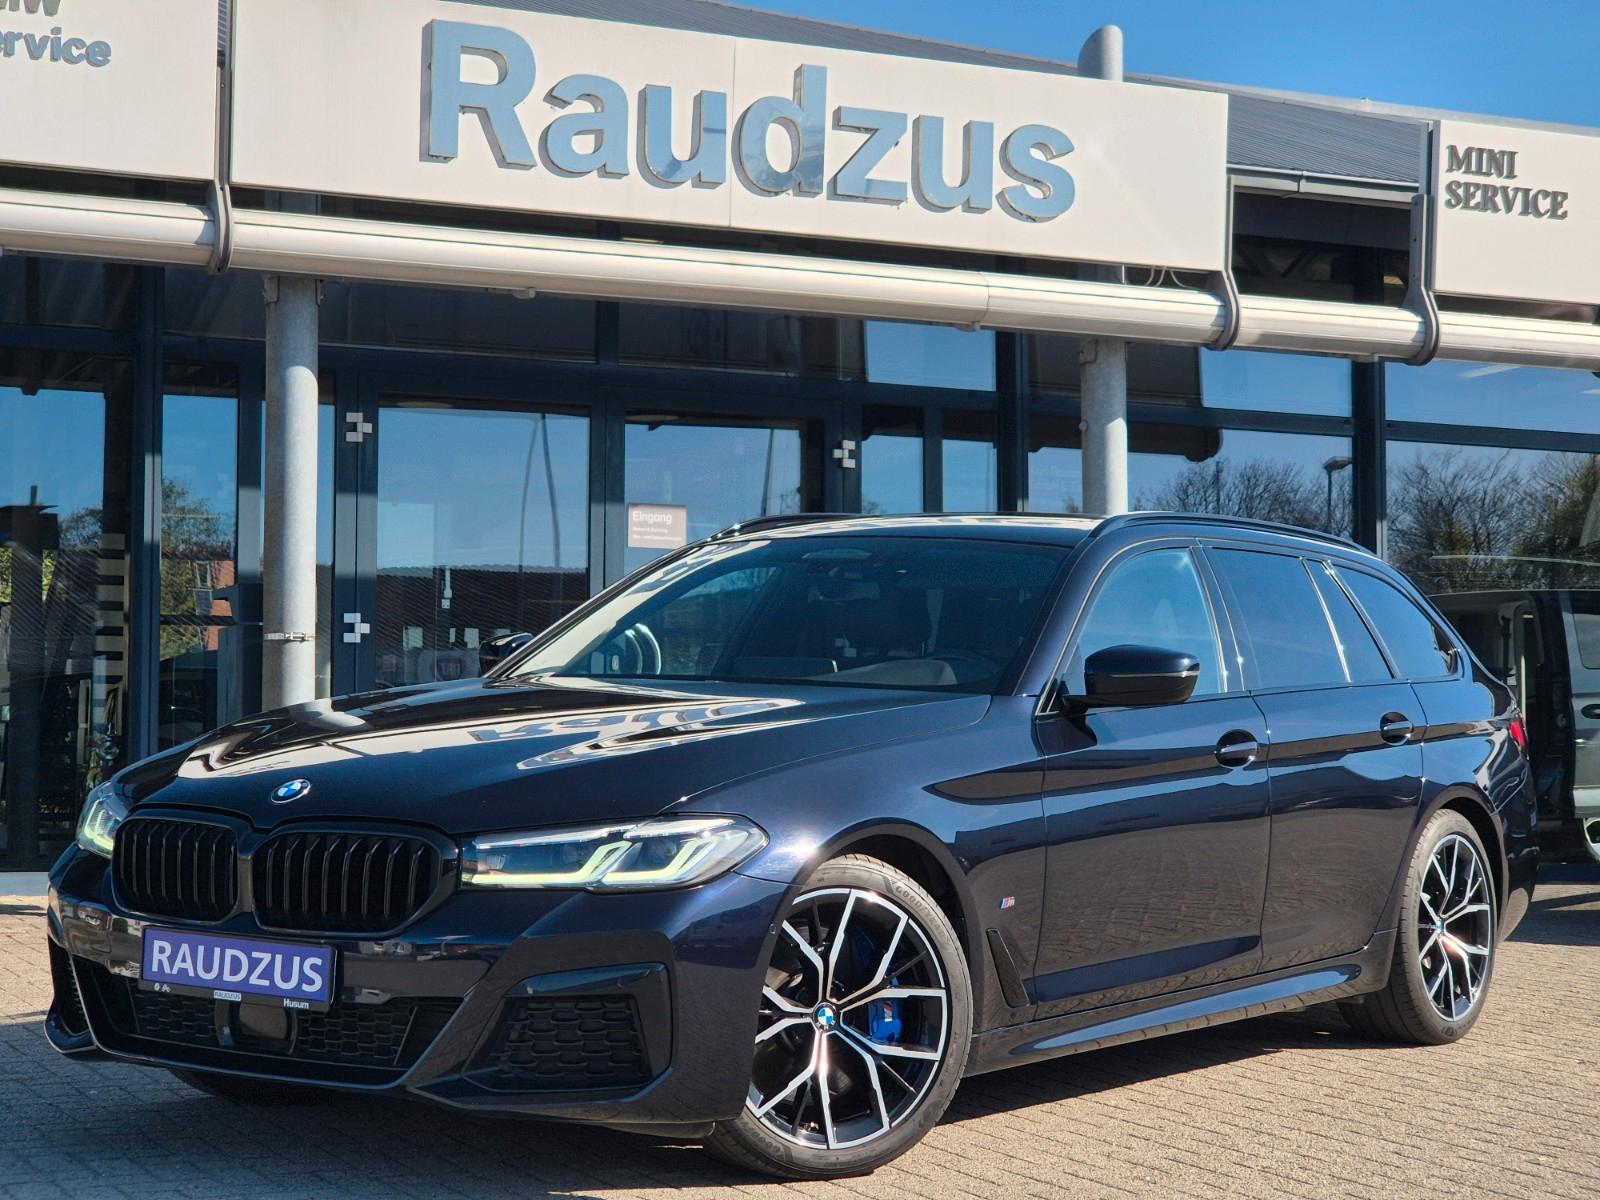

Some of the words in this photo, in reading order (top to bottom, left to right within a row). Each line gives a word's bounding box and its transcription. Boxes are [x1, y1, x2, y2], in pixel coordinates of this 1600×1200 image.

[0, 27, 112, 67] rvice
[419, 19, 1076, 222] Raudzus
[1445, 145, 1518, 180] MINI
[1445, 180, 1568, 220] SERVICE
[632, 511, 673, 526] Eingang
[152, 940, 322, 992] RAUDZUS
[284, 998, 309, 1009] Husum
